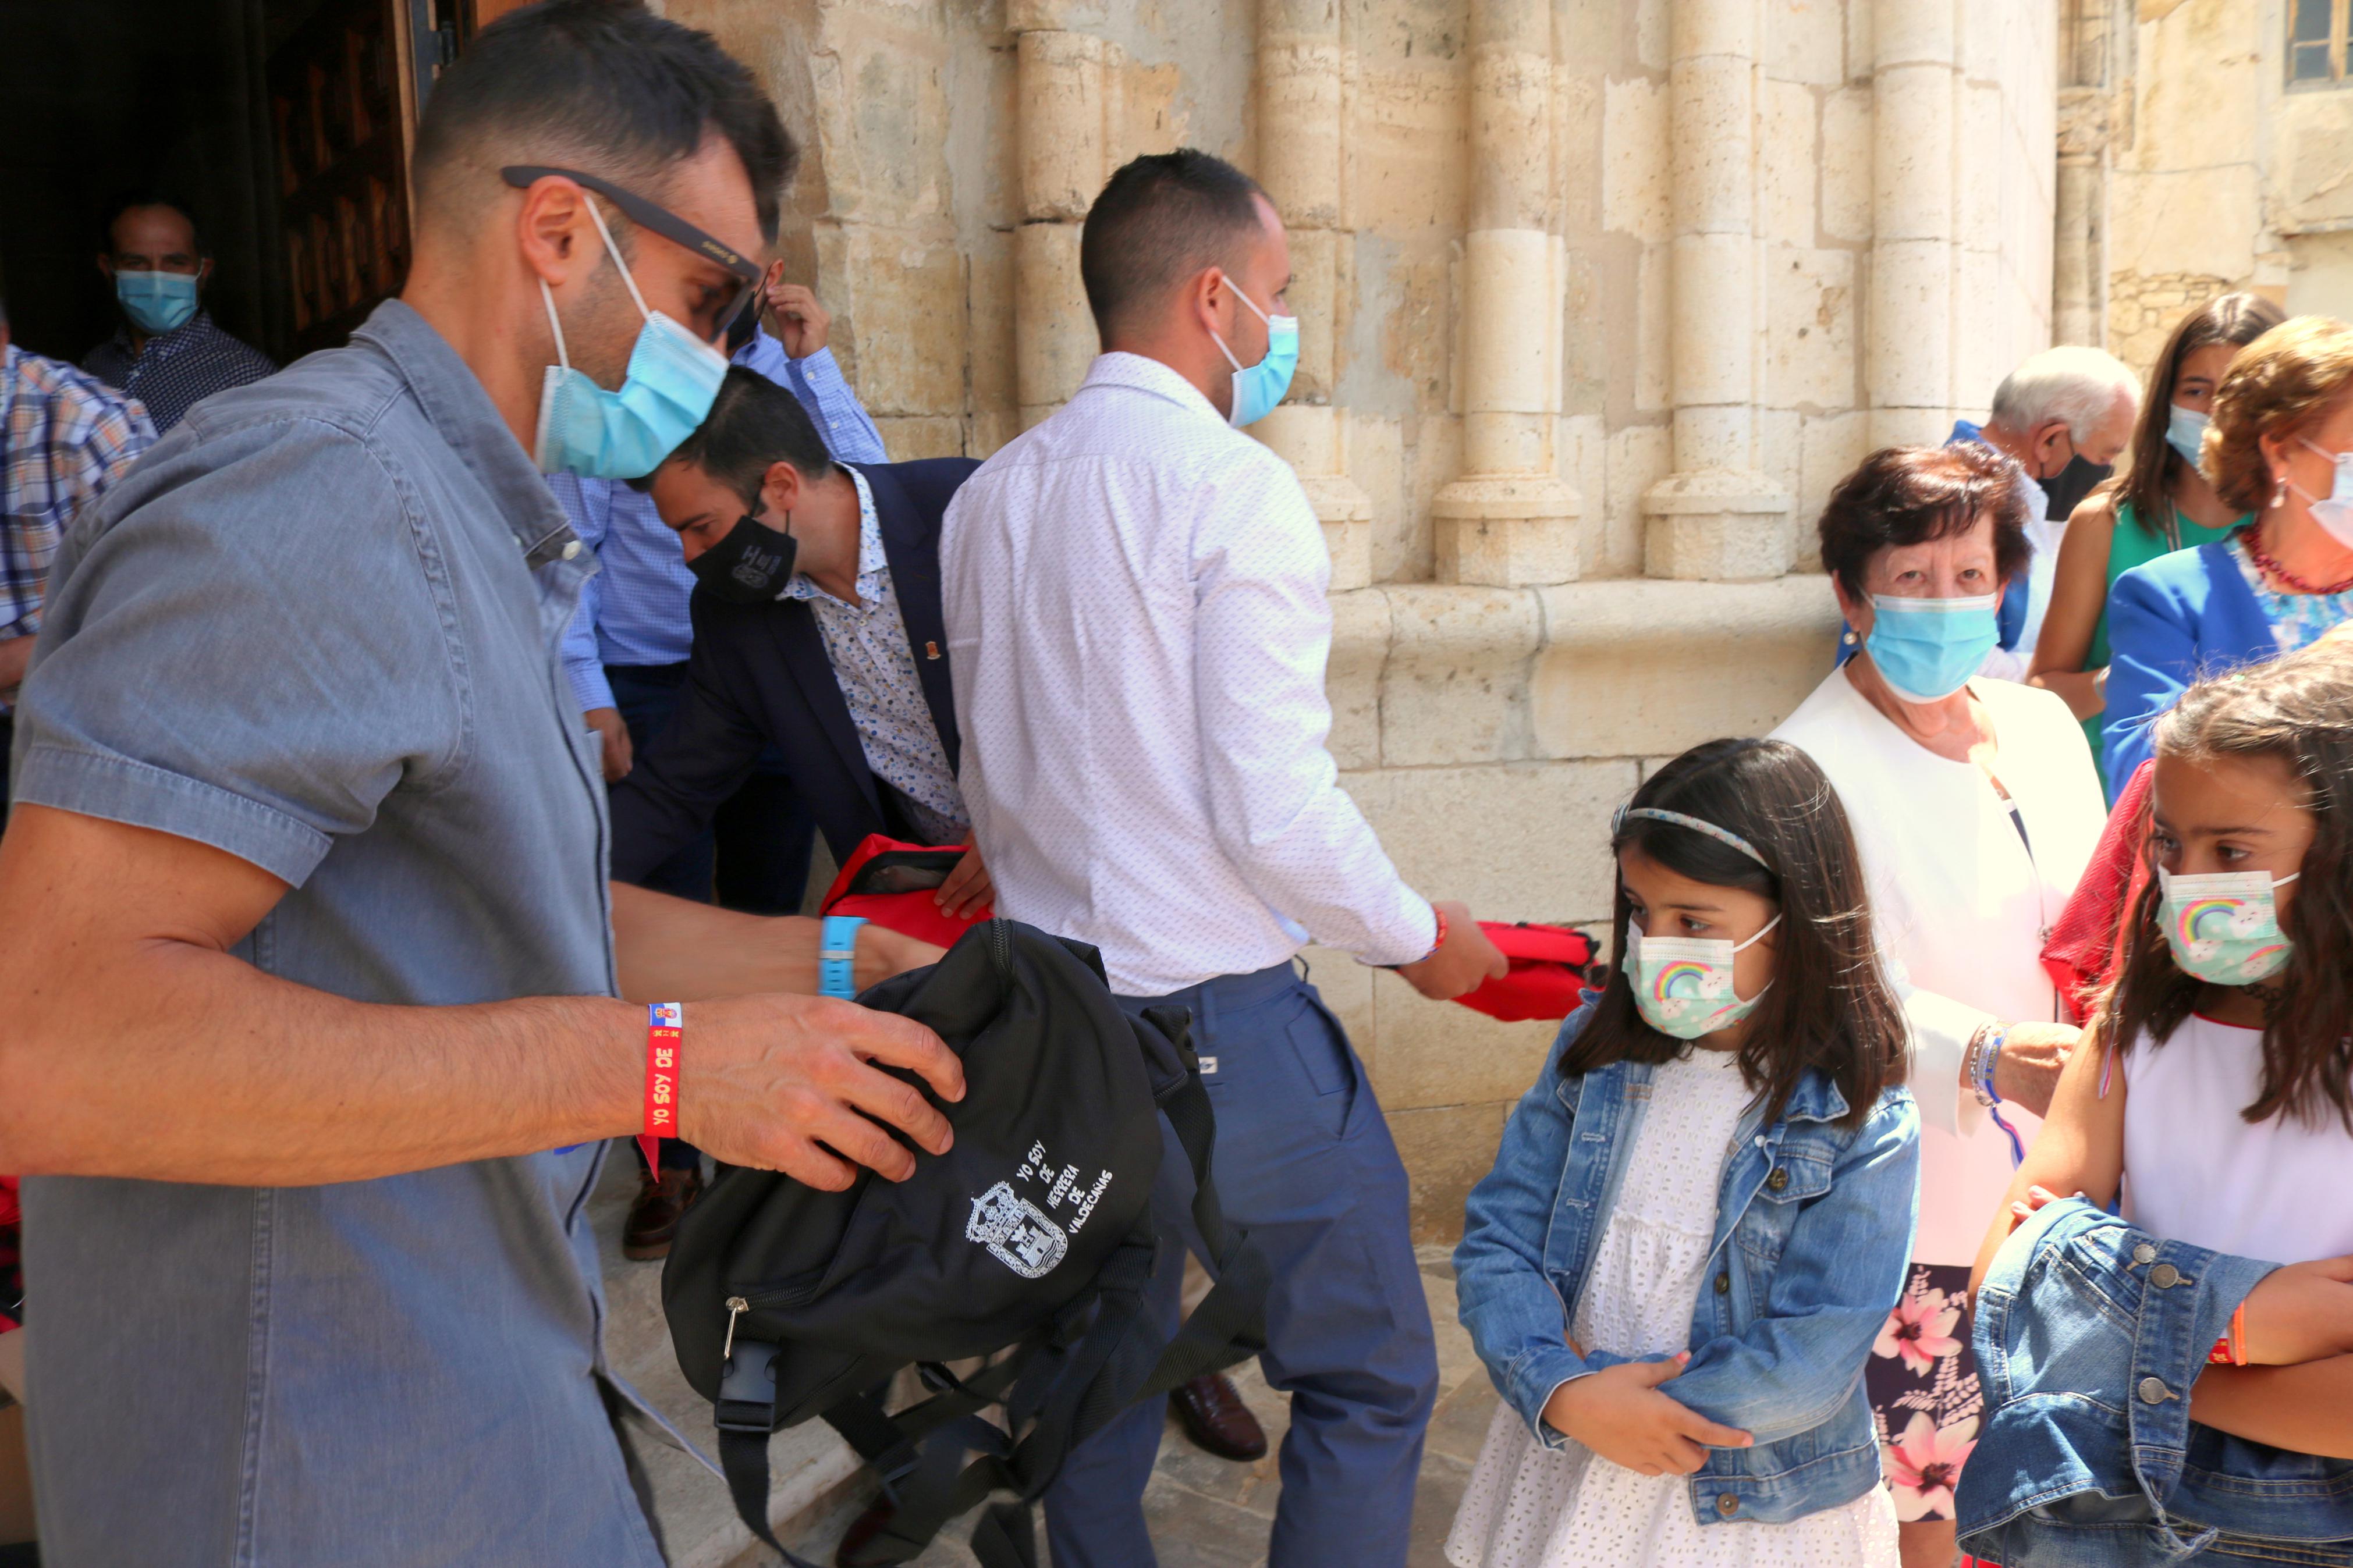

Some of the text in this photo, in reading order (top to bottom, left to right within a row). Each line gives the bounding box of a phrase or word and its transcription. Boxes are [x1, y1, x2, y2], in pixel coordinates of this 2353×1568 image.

[652, 1048, 673, 1125] YO SOY DE
[1016, 1139, 1046, 1182] YO SOY
[1039, 1163, 1055, 1184] DE
[1046, 1164, 1080, 1209] HERRERA
[1068, 1186, 1085, 1205] DE
[1069, 1169, 1113, 1233] VALDECAÑAS
